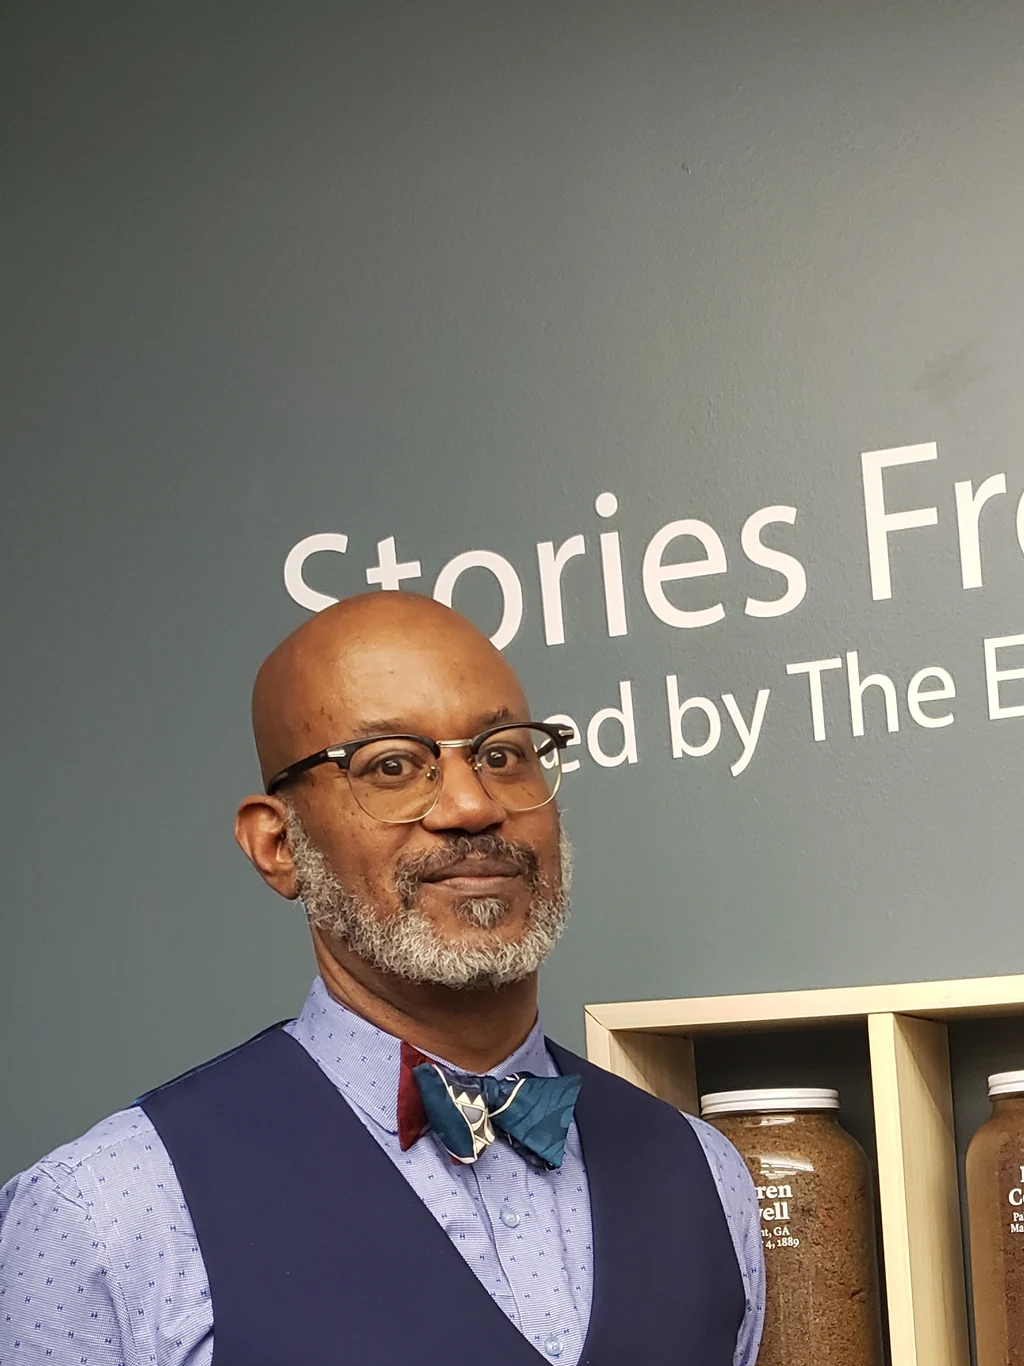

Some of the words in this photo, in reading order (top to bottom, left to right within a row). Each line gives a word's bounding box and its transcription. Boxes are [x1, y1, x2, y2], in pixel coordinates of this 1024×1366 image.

[284, 491, 808, 651] Stories
[666, 675, 770, 776] by
[787, 650, 956, 743] The
[765, 1240, 776, 1250] 4,
[777, 1237, 800, 1248] 1889
[773, 1226, 790, 1237] GA
